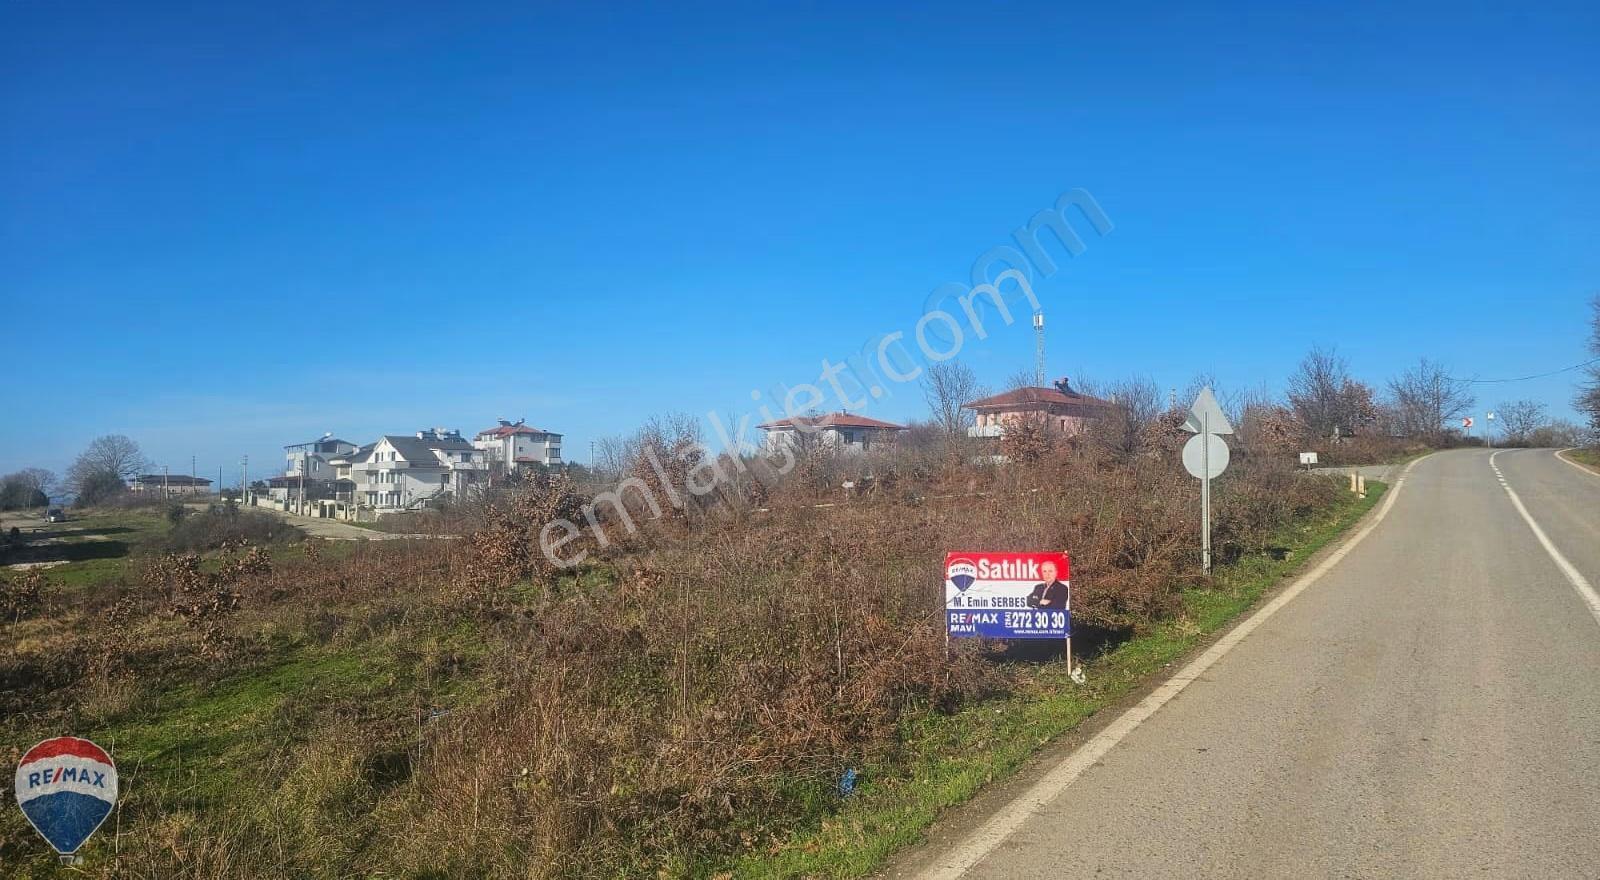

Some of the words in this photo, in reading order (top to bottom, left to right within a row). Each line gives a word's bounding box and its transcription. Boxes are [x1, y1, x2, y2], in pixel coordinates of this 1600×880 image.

[978, 558, 1040, 579] Satılık
[953, 597, 965, 608] M.
[967, 597, 989, 608] Emin
[991, 597, 1026, 608] SERBES
[950, 613, 999, 624] RE/MAX
[1012, 611, 1032, 628] 272
[1034, 611, 1049, 629] 30
[1051, 611, 1065, 629] 30
